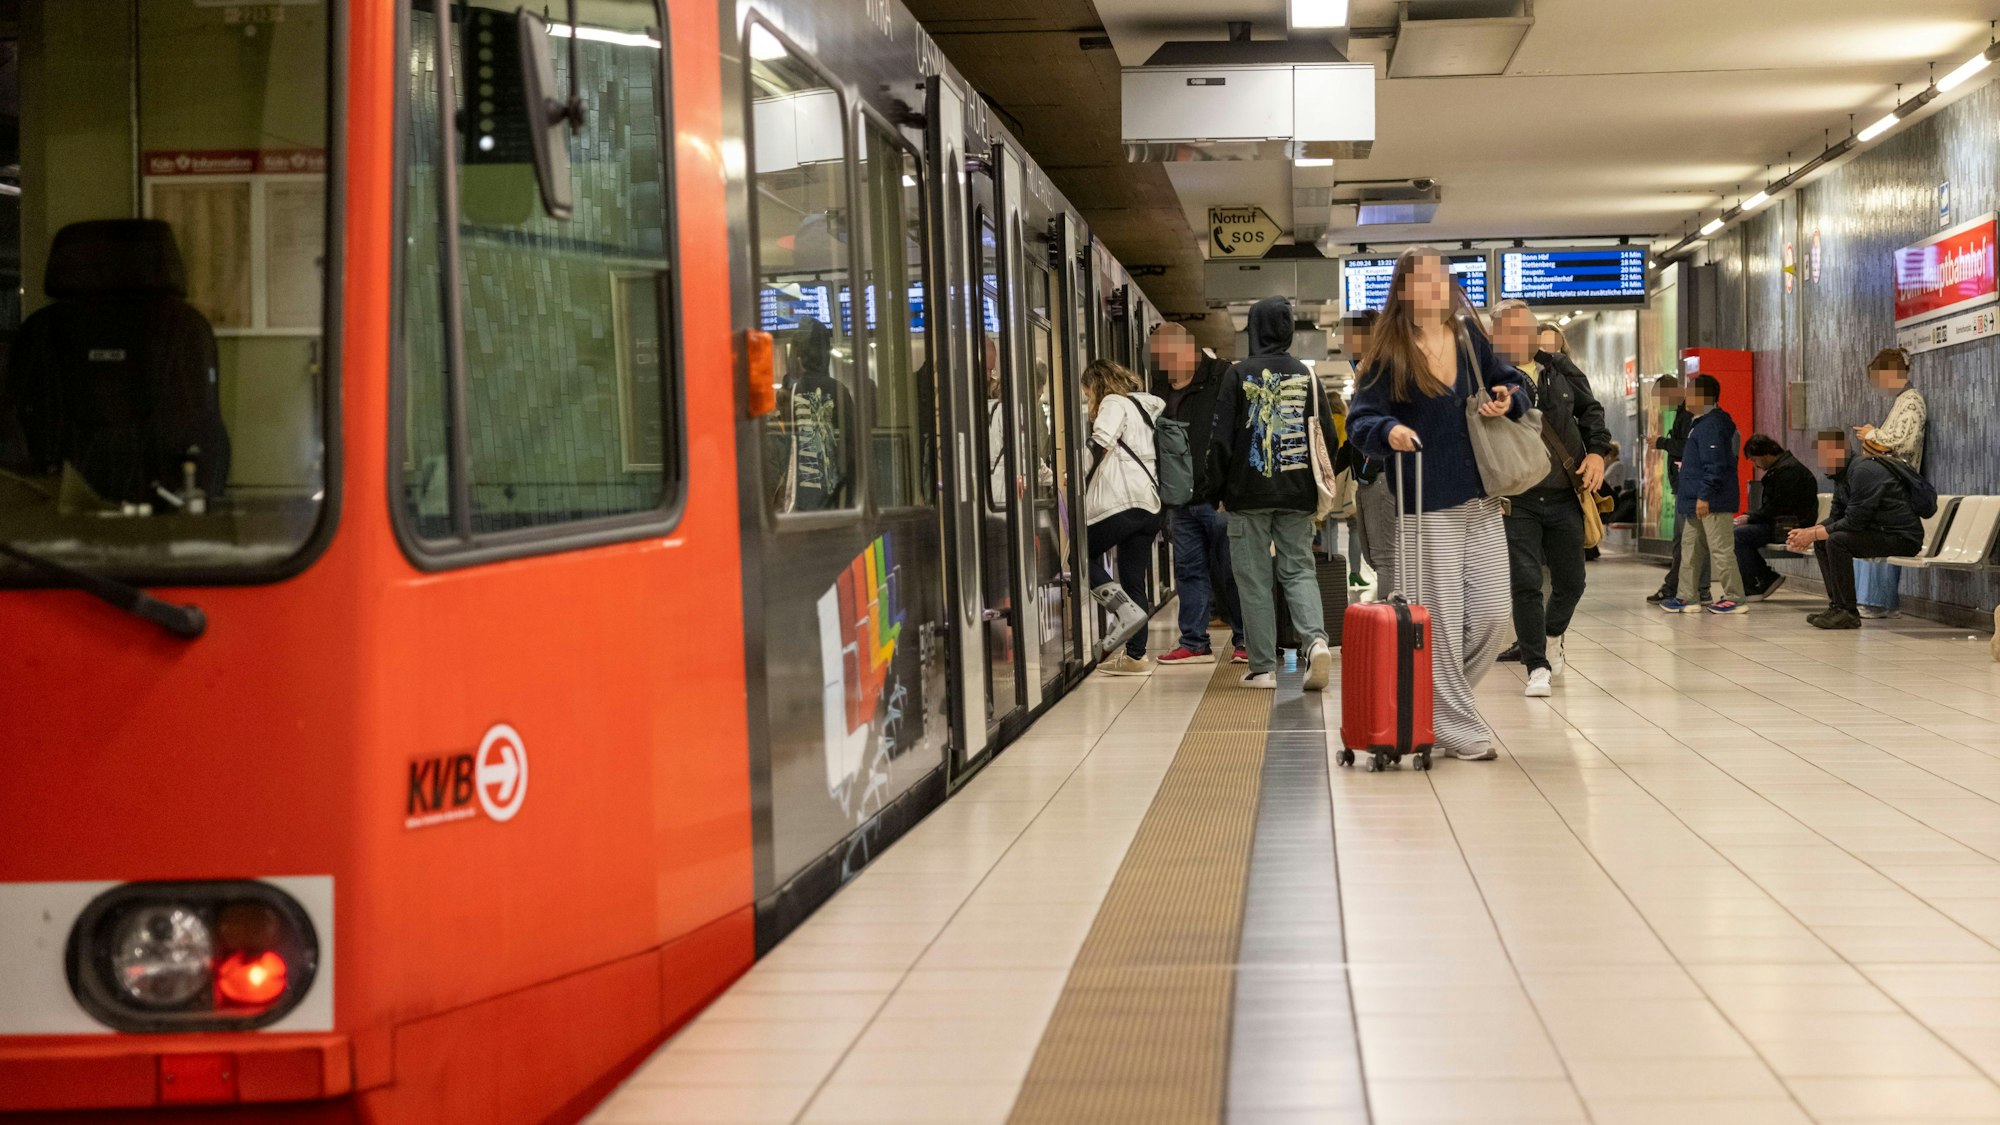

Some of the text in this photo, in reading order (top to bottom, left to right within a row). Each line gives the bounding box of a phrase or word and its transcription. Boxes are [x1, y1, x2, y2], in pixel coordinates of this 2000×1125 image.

[1213, 212, 1256, 224] Notruf
[1232, 231, 1265, 243] SOS
[1547, 290, 1576, 298] Ebertplatz
[407, 754, 475, 815] KVB
